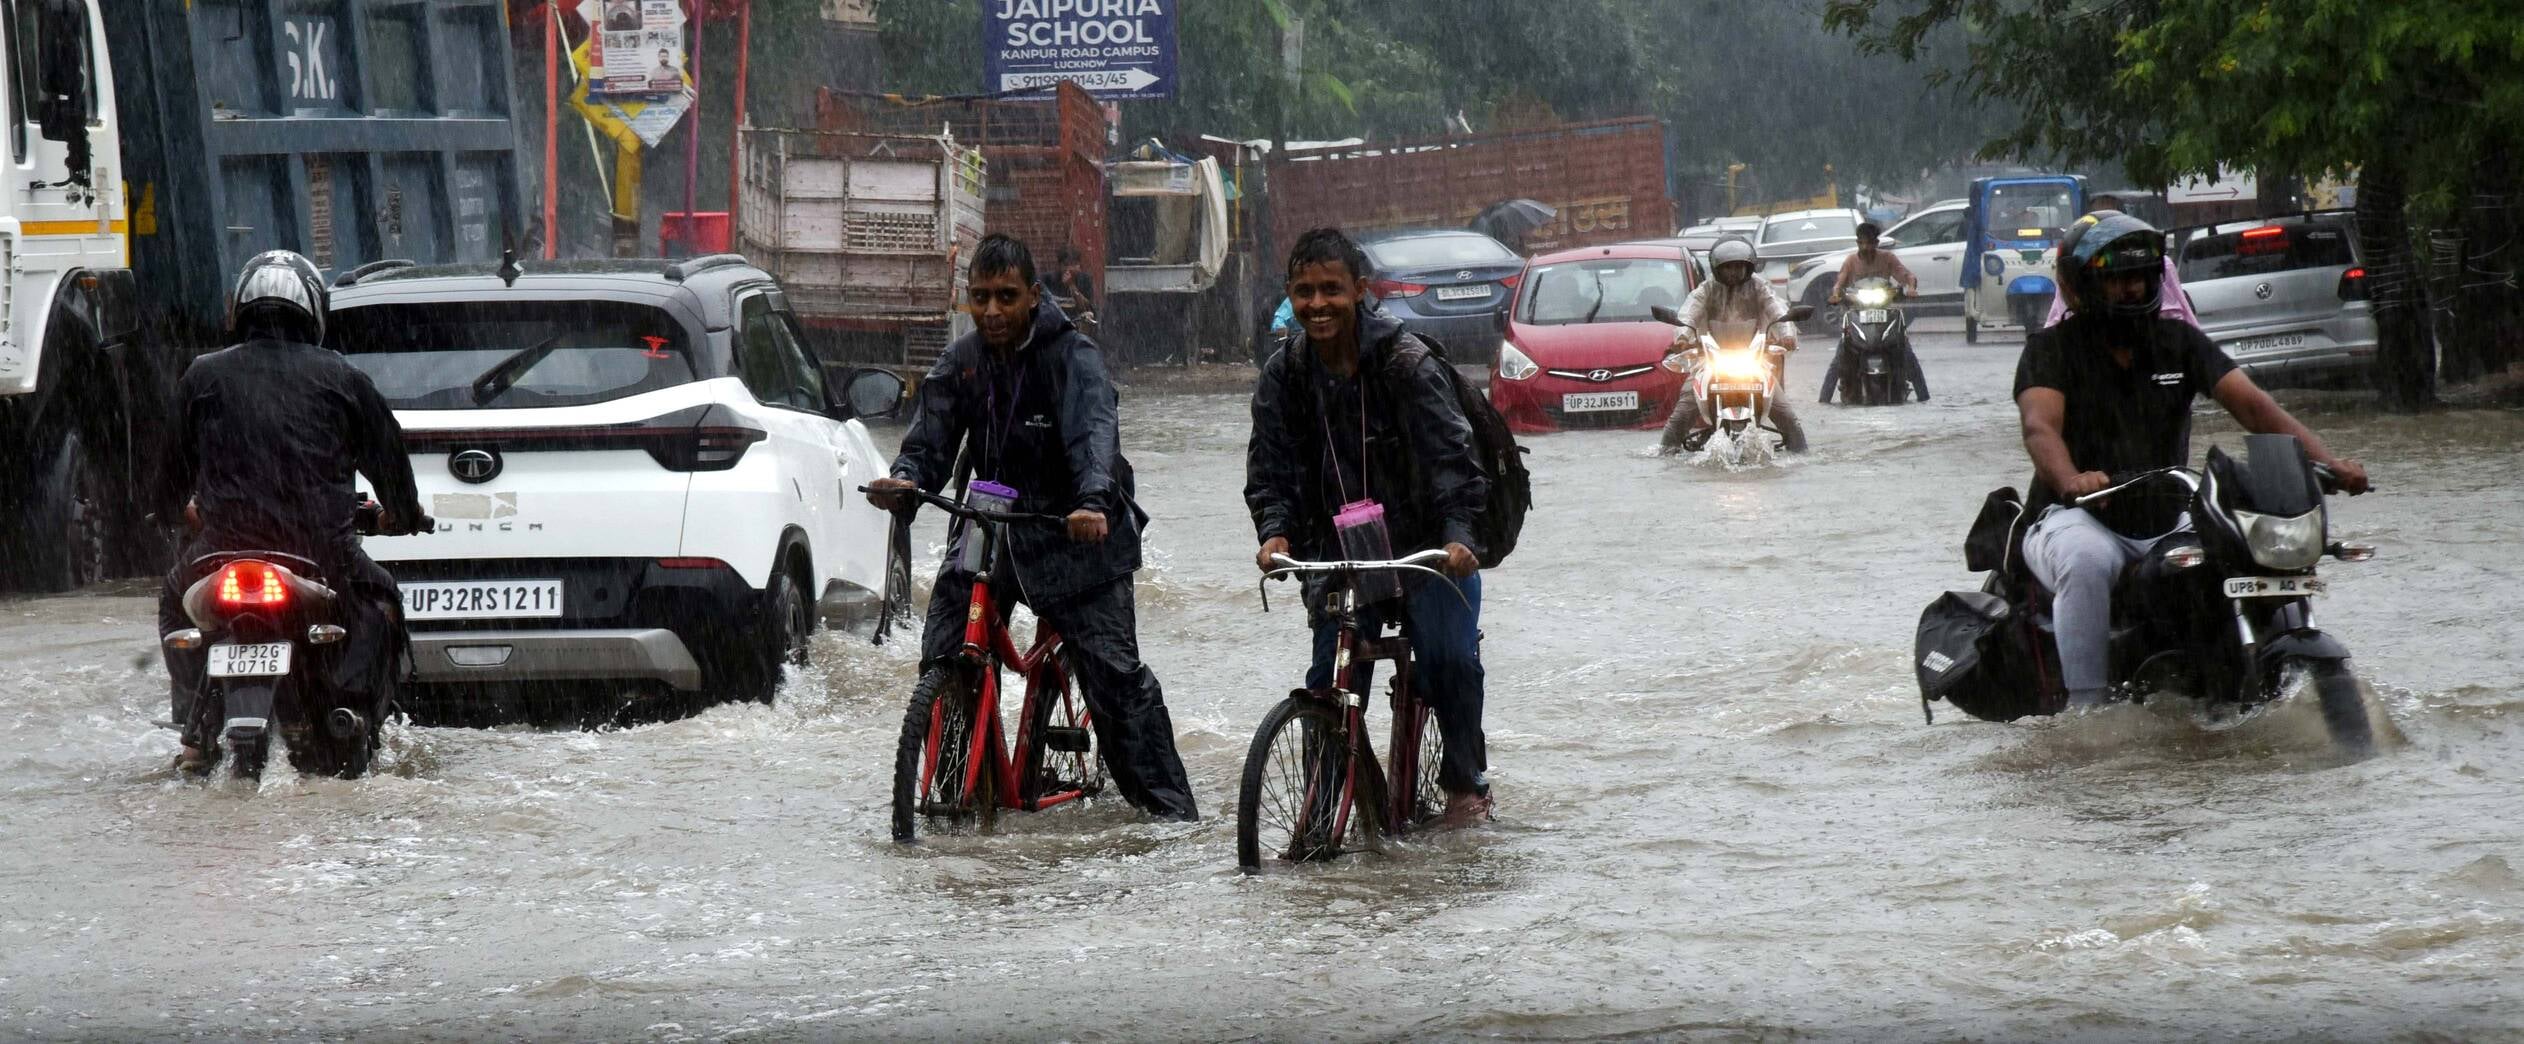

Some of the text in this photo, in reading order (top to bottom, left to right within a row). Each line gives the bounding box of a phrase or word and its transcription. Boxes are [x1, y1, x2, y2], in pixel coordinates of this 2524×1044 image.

[996, 0, 1162, 19] JAIPURIA
[1007, 20, 1153, 46] SCHOOL
[1001, 46, 1160, 60] KANPUR ROAD CAMPUS
[1054, 60, 1108, 69] LUCKNOW
[1570, 396, 1636, 409] UP32JK6911
[438, 522, 543, 532] UNCH
[412, 586, 556, 612] UP32RS1211
[228, 645, 279, 660] UP32G
[227, 660, 278, 674] K0716
